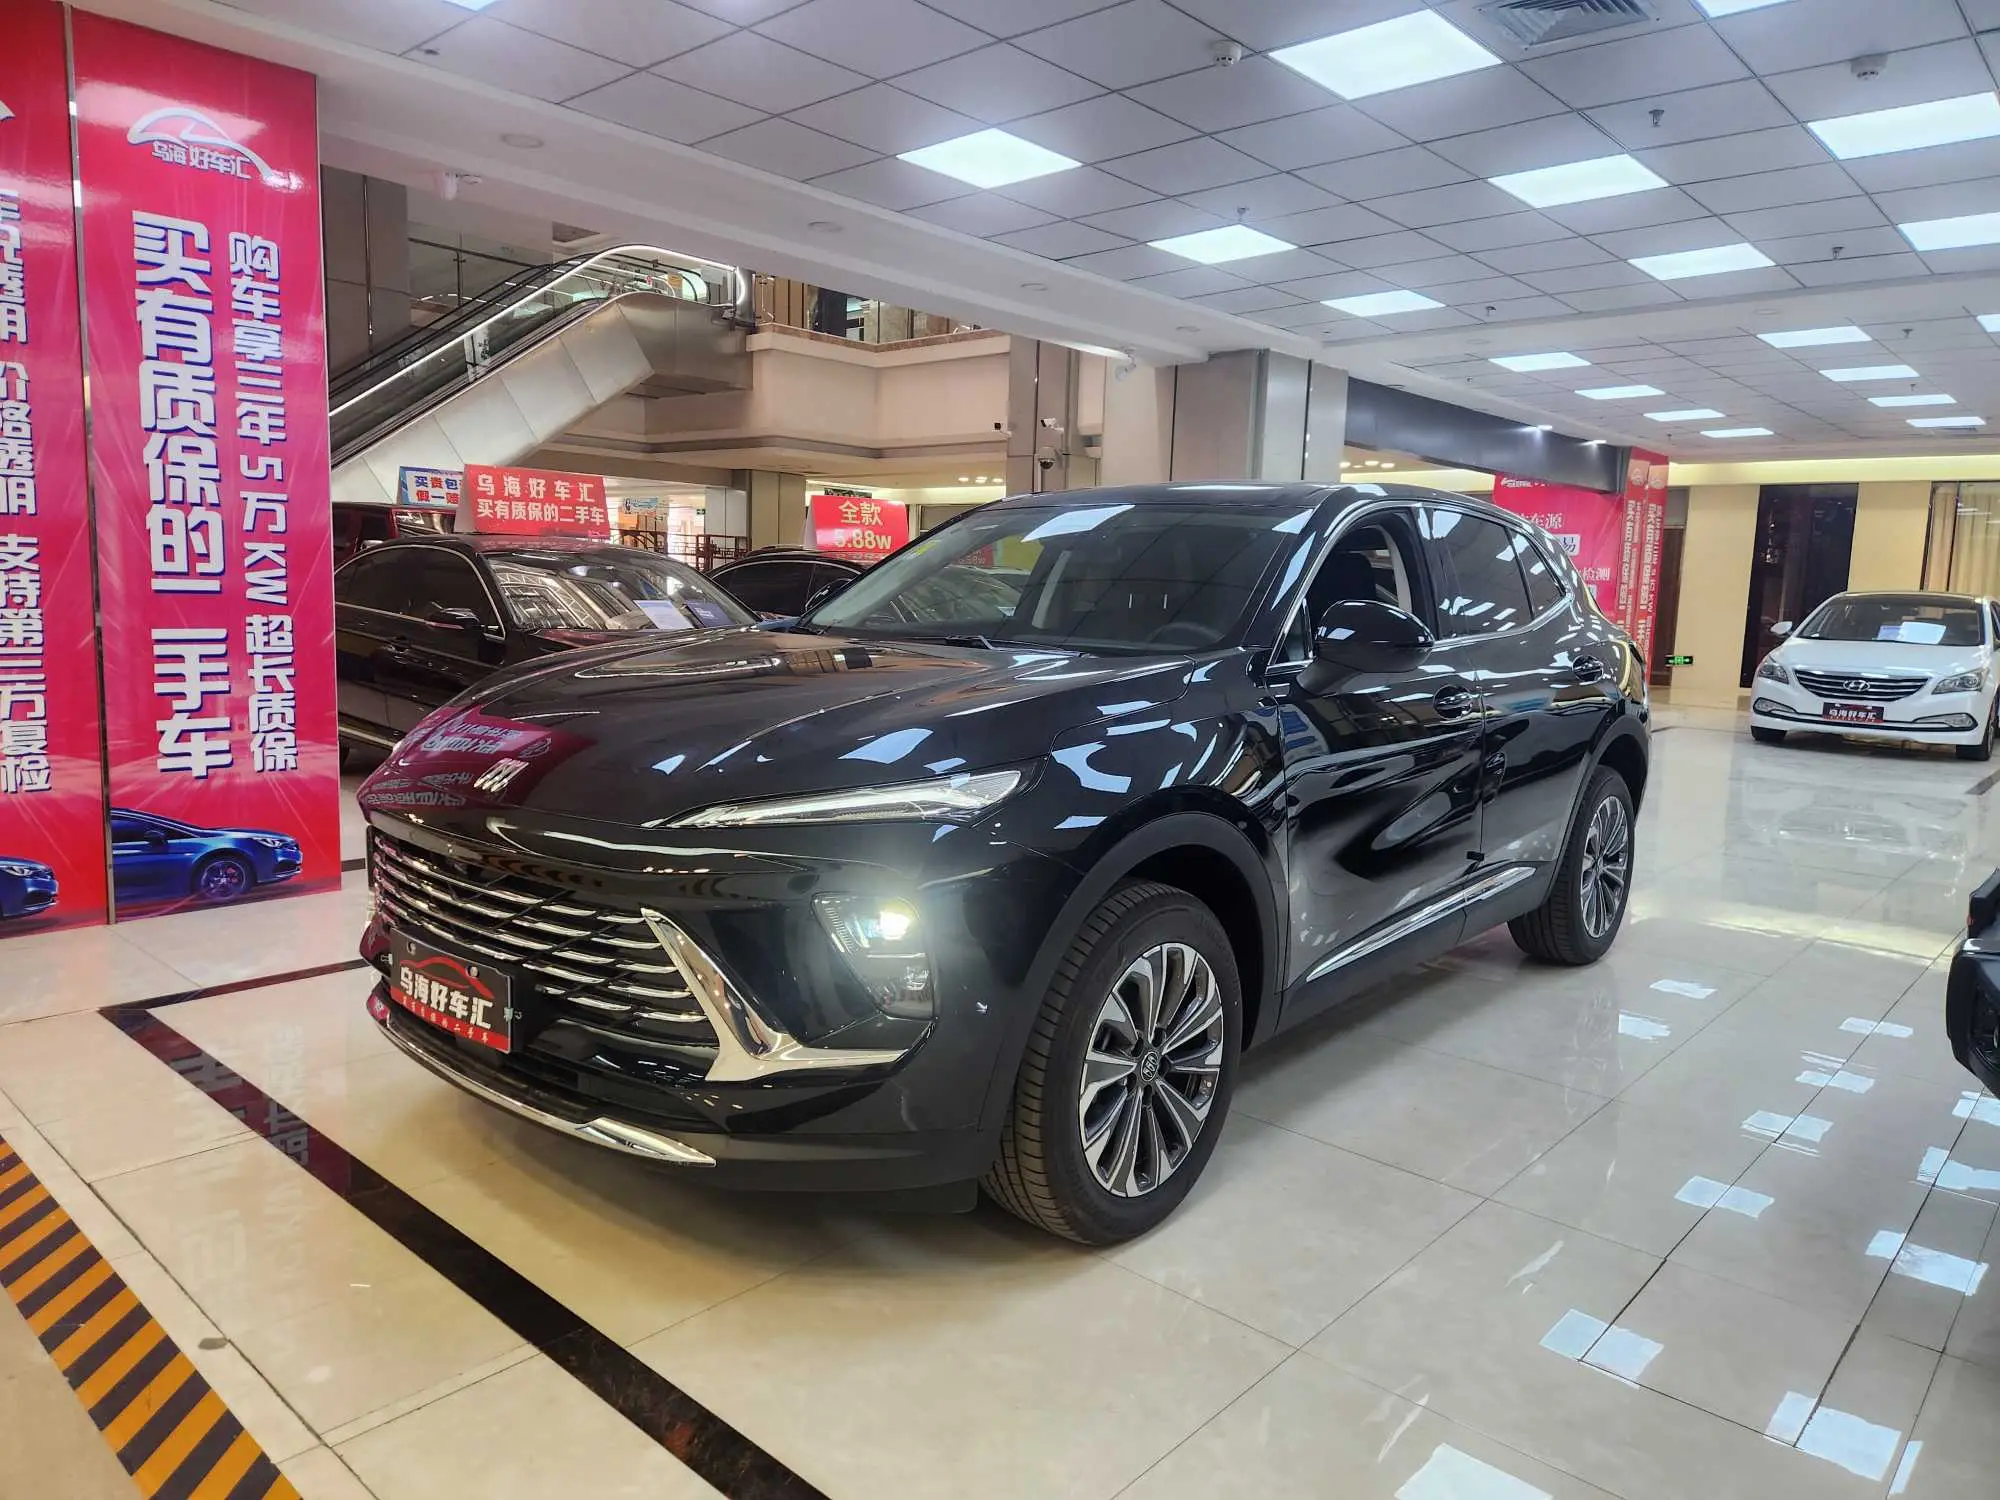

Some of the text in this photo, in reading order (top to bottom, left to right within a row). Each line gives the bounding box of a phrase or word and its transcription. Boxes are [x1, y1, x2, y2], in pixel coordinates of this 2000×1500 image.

[152, 140, 253, 181] 乌海好车汇
[132, 209, 234, 778] 买有质保的二手车
[414, 475, 462, 490] 买贵包
[477, 473, 596, 503] 乌海好车汇
[476, 499, 606, 526] 买有质保的二手车
[838, 500, 884, 526] 全款
[0, 535, 52, 793] 支持第三方复检
[400, 966, 494, 1030] 乌海好车汇
